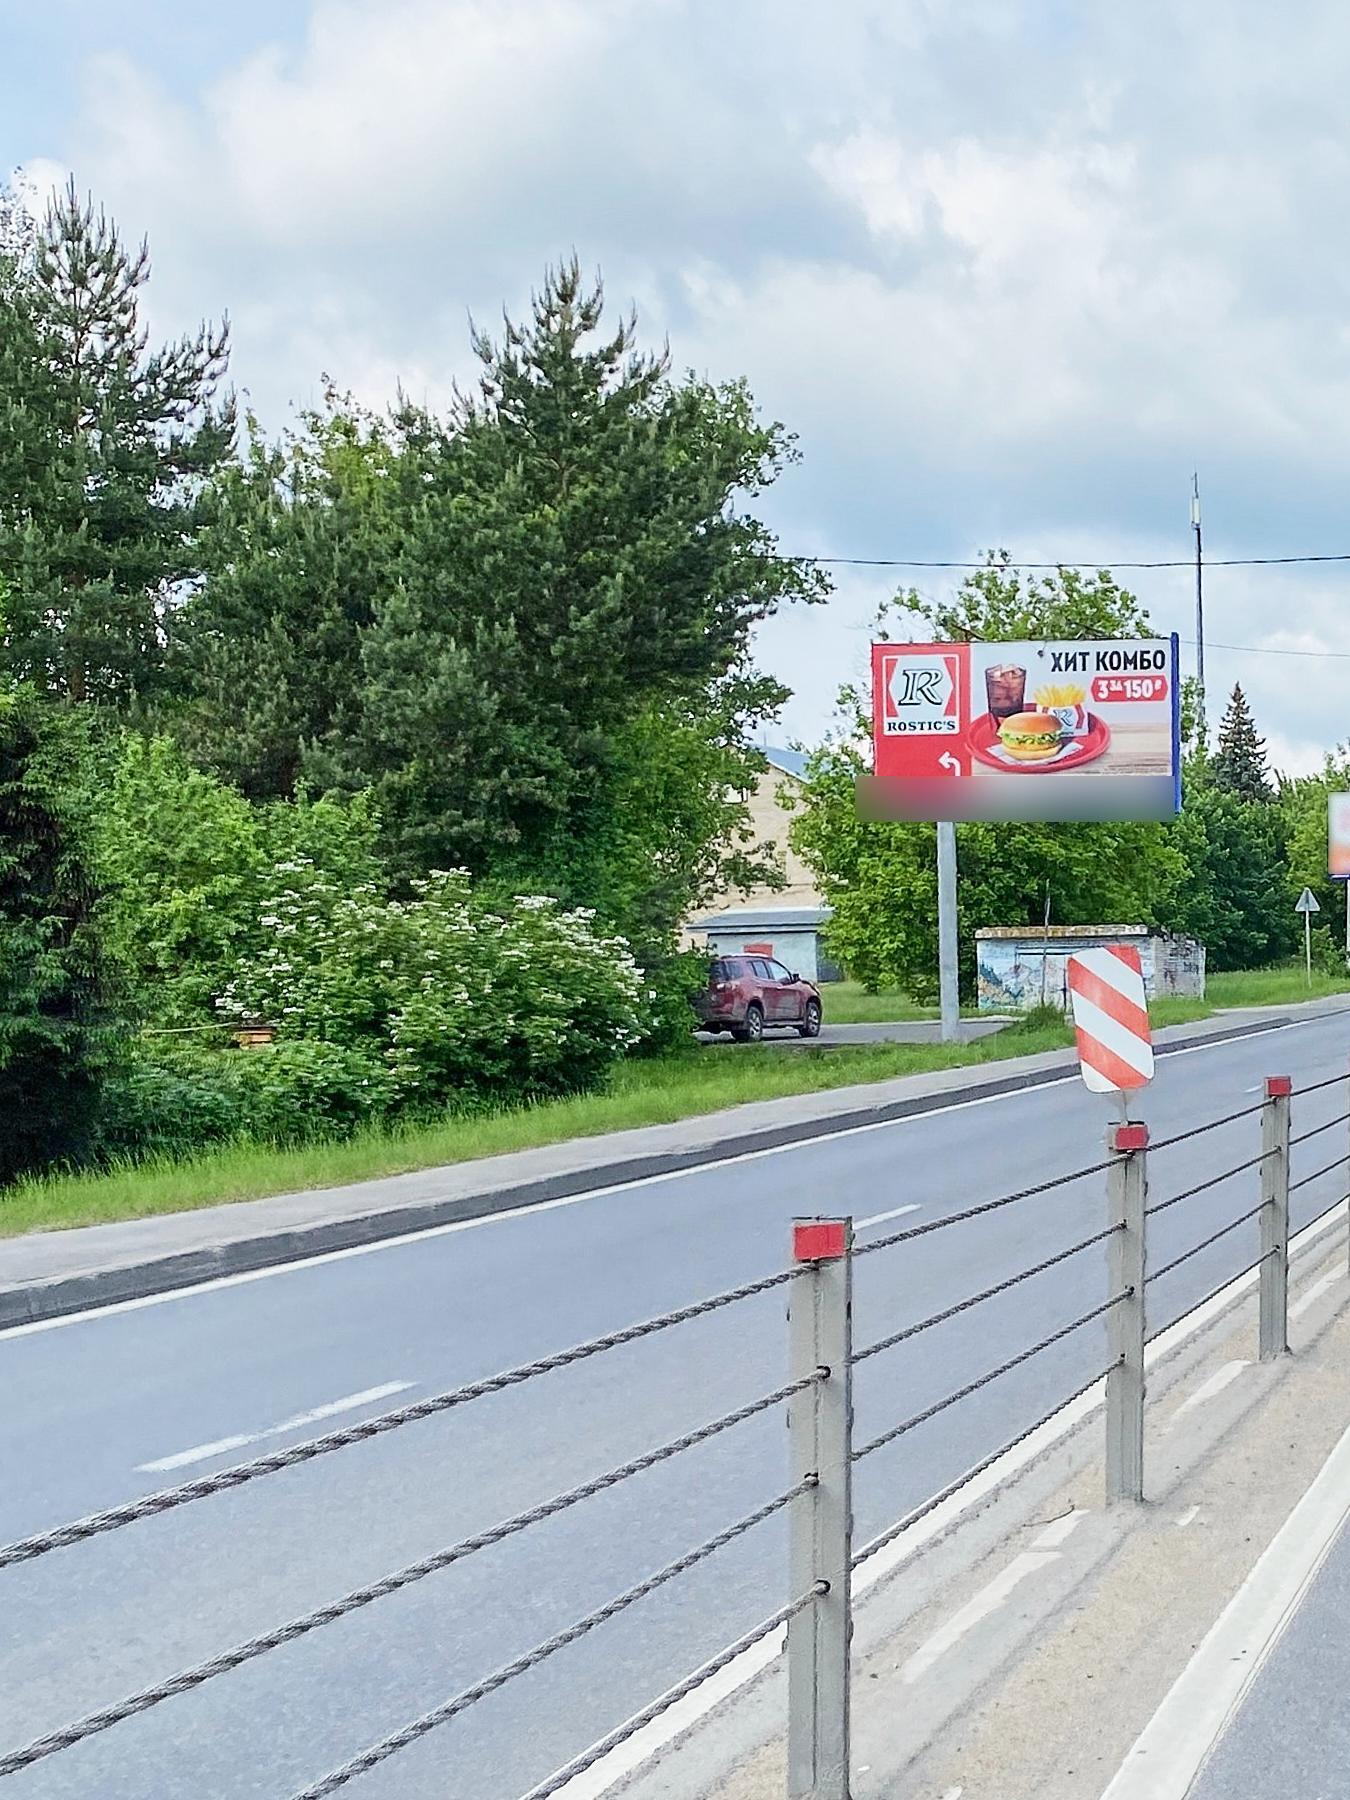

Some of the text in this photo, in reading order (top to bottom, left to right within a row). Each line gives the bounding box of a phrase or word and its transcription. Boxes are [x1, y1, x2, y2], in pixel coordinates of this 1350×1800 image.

[1051, 649, 1166, 672] ХИТ КОМБО
[887, 720, 956, 732] ROSTIC'S
